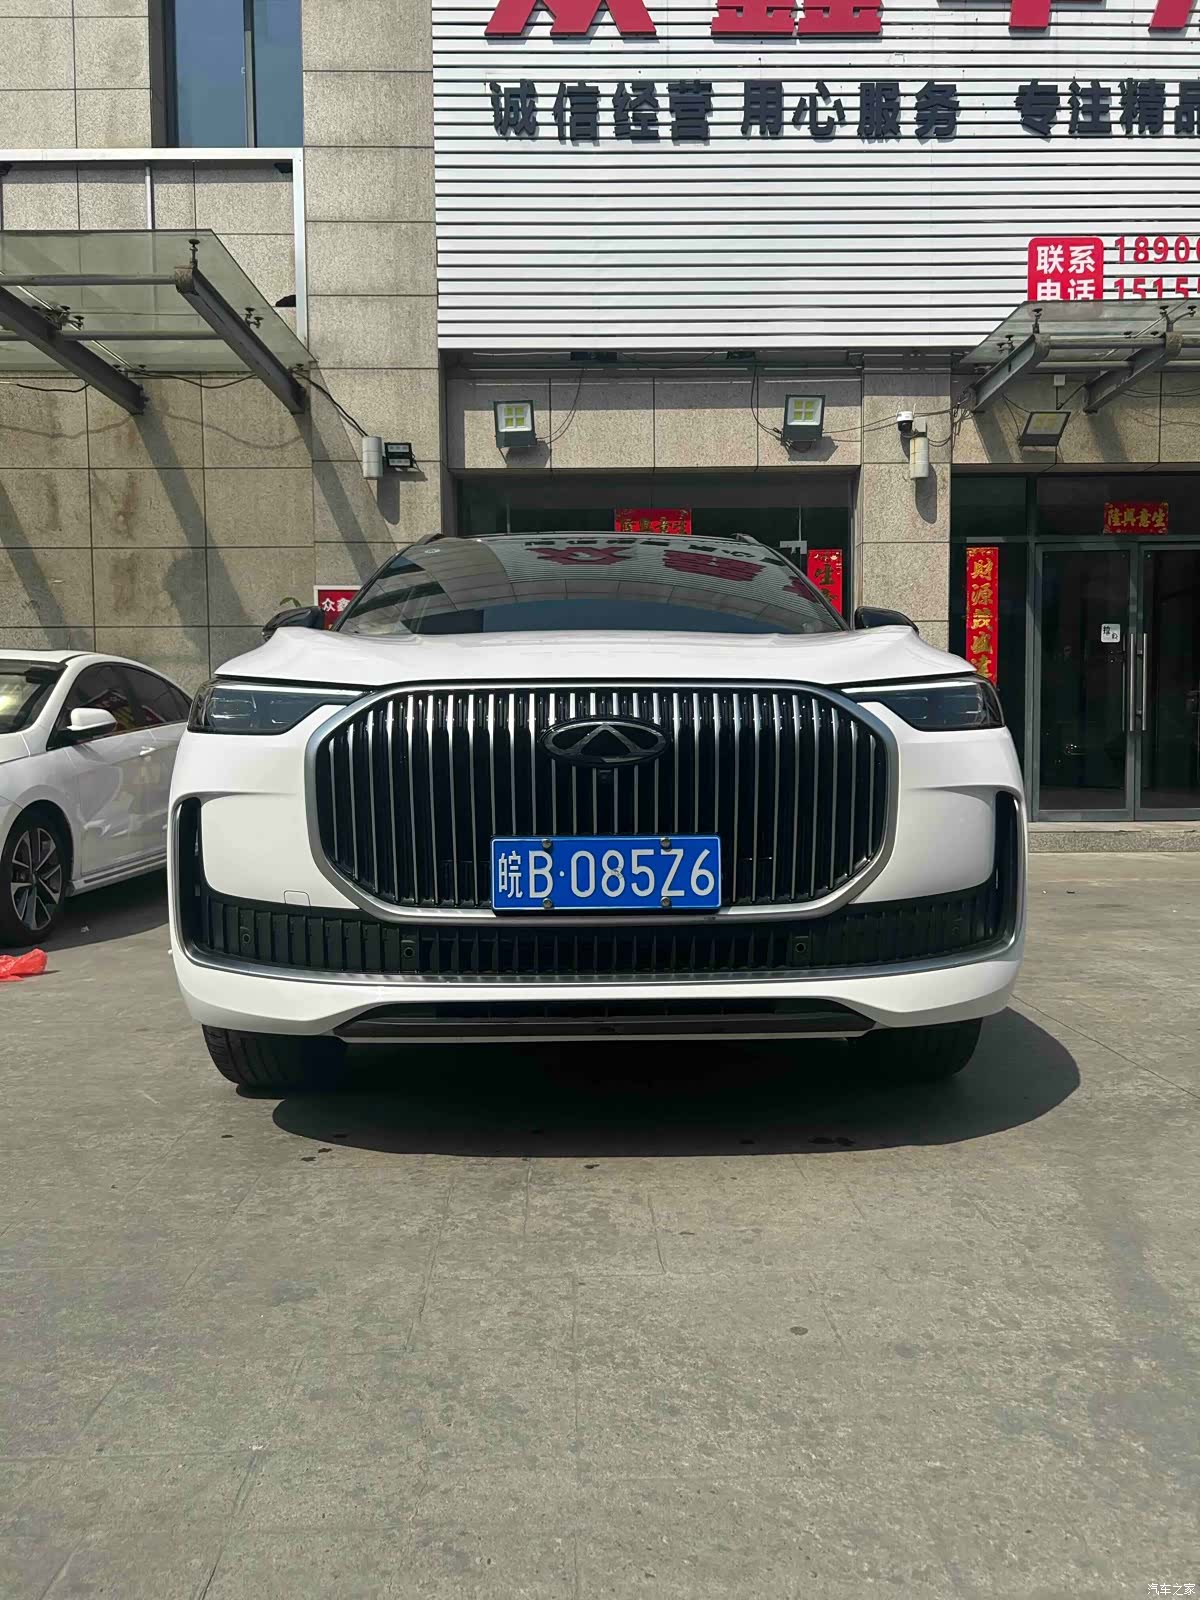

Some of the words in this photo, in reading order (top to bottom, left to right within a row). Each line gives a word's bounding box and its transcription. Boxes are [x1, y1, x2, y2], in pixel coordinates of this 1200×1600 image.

[489, 79, 713, 141] 诚信经营
[740, 79, 960, 138] 用心服务
[1036, 245, 1096, 274] 联系
[1114, 235, 1200, 264] 1890
[1114, 276, 1200, 300] 1515
